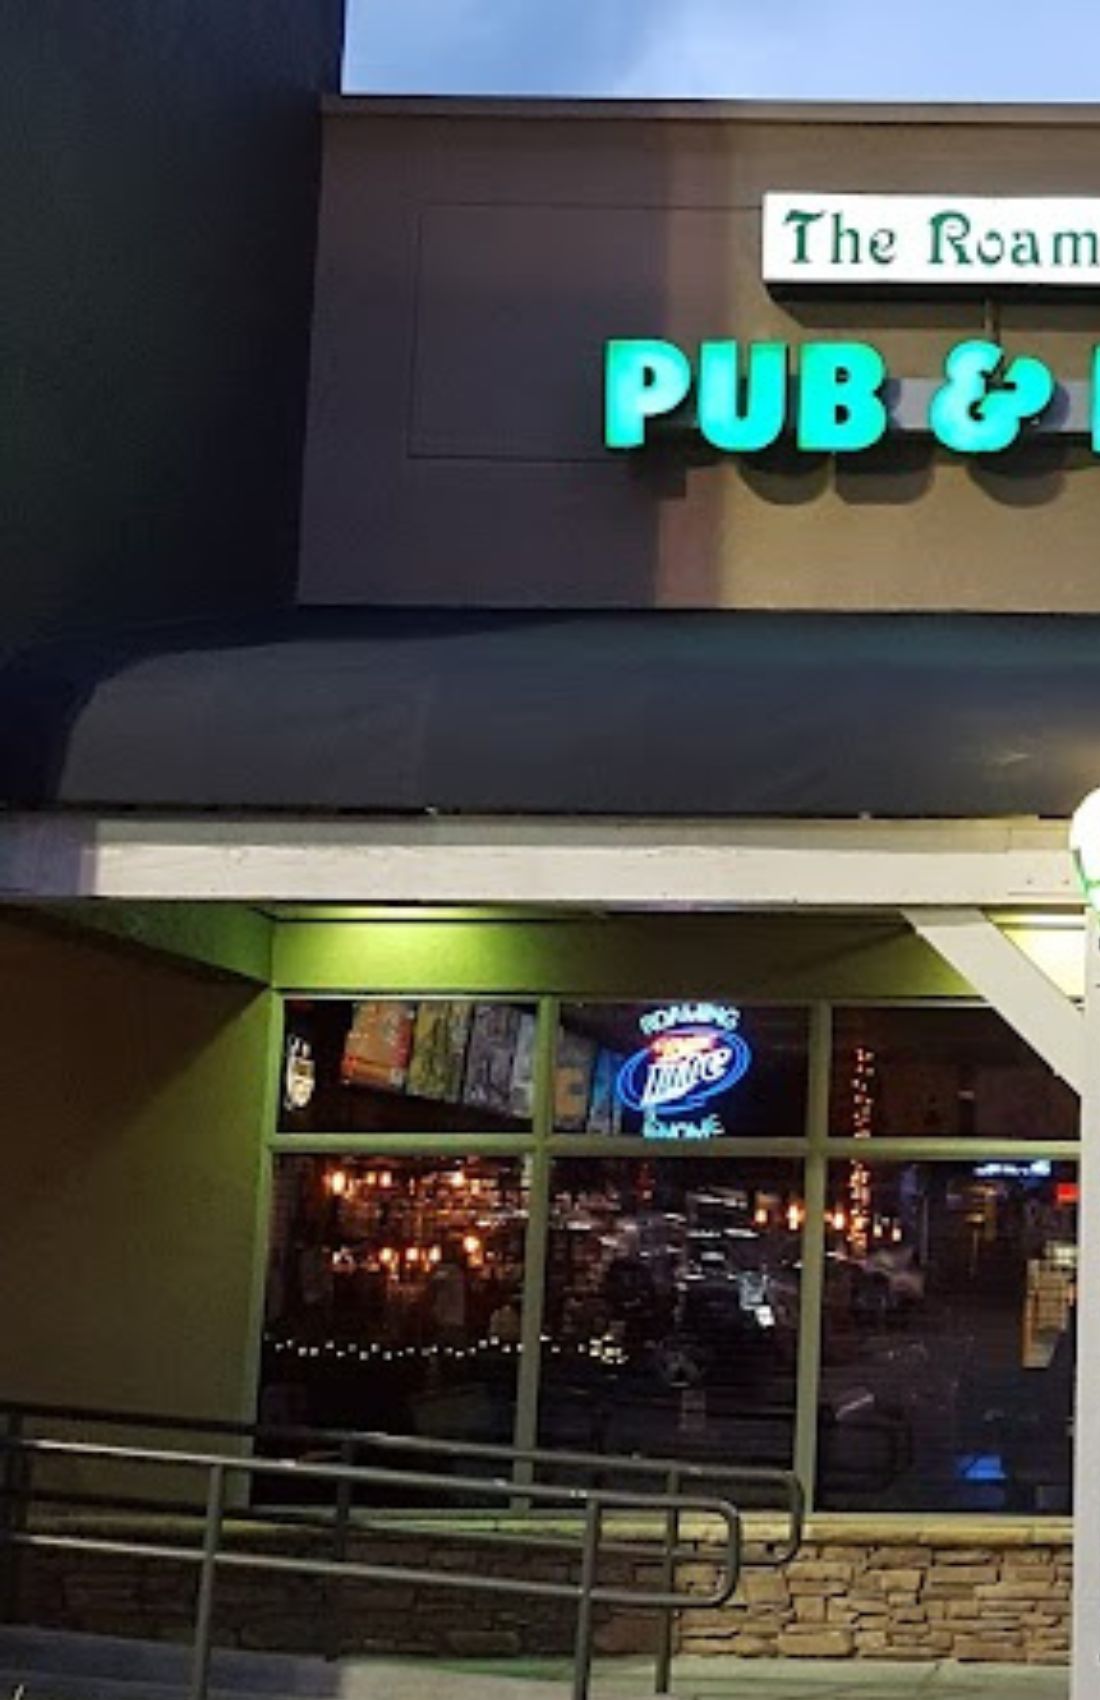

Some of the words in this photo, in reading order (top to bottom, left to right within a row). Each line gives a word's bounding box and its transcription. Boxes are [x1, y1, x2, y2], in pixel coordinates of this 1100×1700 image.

[784, 210, 897, 265] The
[605, 339, 885, 452] PUB
[930, 339, 1053, 452] &
